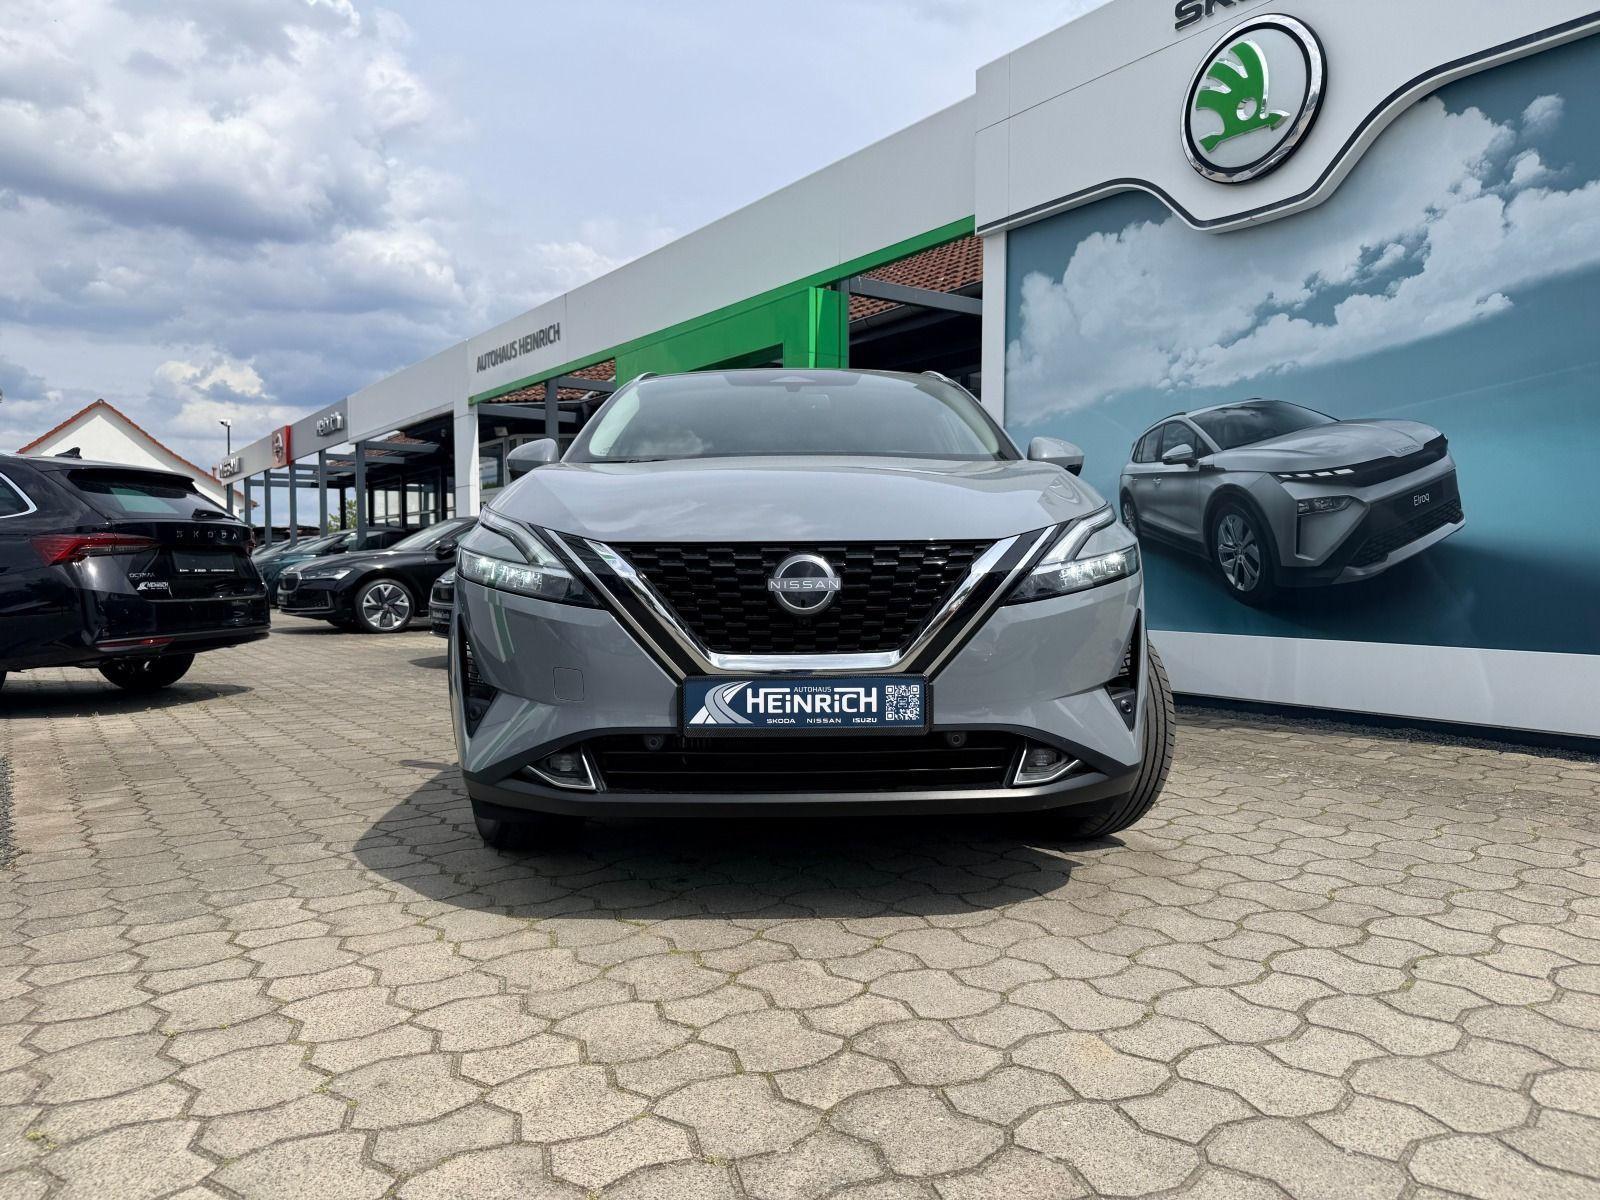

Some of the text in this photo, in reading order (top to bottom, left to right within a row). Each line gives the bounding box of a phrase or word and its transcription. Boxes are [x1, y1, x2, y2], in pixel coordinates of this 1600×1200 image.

[476, 322, 561, 373] AUTOHAUS HEINRICH
[1413, 493, 1430, 507] Elroq
[770, 579, 840, 590] NISSAN
